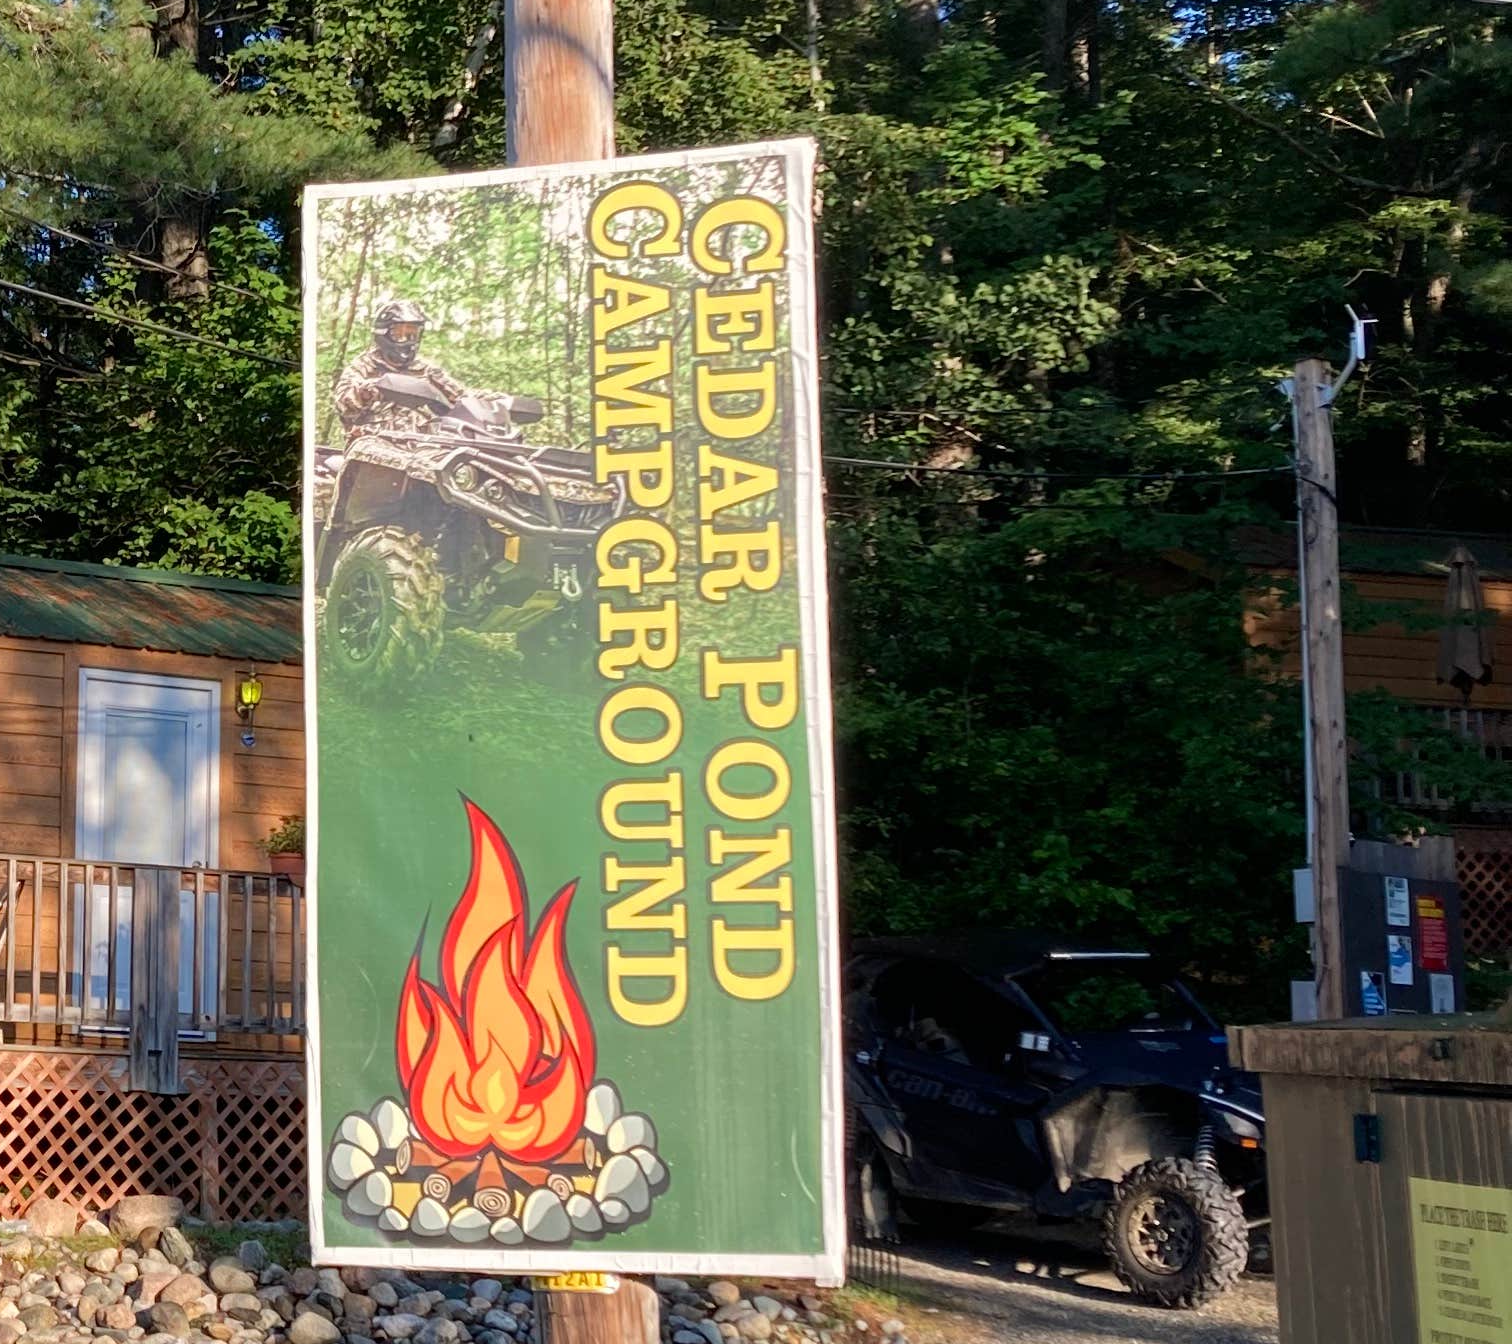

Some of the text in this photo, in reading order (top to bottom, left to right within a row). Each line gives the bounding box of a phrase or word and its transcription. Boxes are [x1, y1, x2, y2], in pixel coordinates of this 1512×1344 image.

[589, 181, 688, 1028] CAMPGROUND
[695, 197, 798, 1002] CEDAR POND
